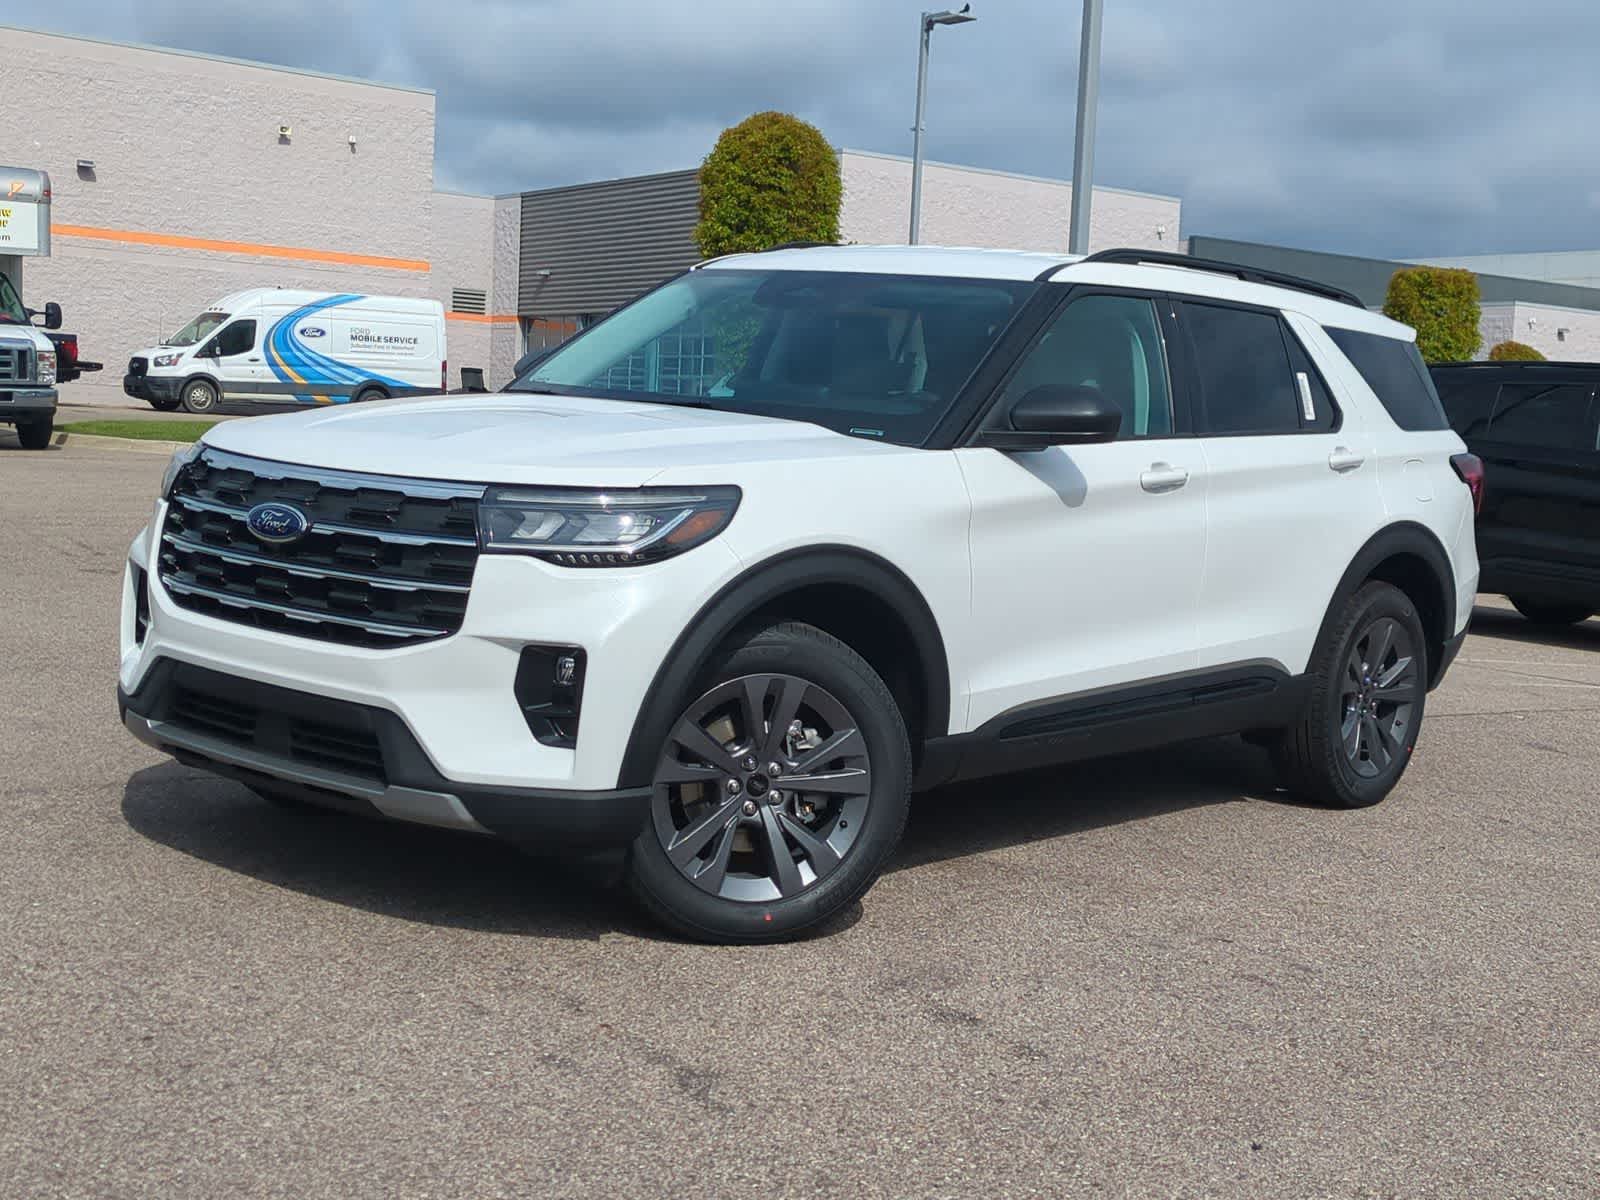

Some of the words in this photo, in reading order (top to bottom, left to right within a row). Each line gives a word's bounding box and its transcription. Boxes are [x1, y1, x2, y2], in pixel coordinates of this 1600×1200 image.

[304, 327, 322, 337] Ford
[350, 335, 382, 343] MOBILE
[383, 336, 418, 345] SERVICE
[256, 510, 290, 532] Ford
